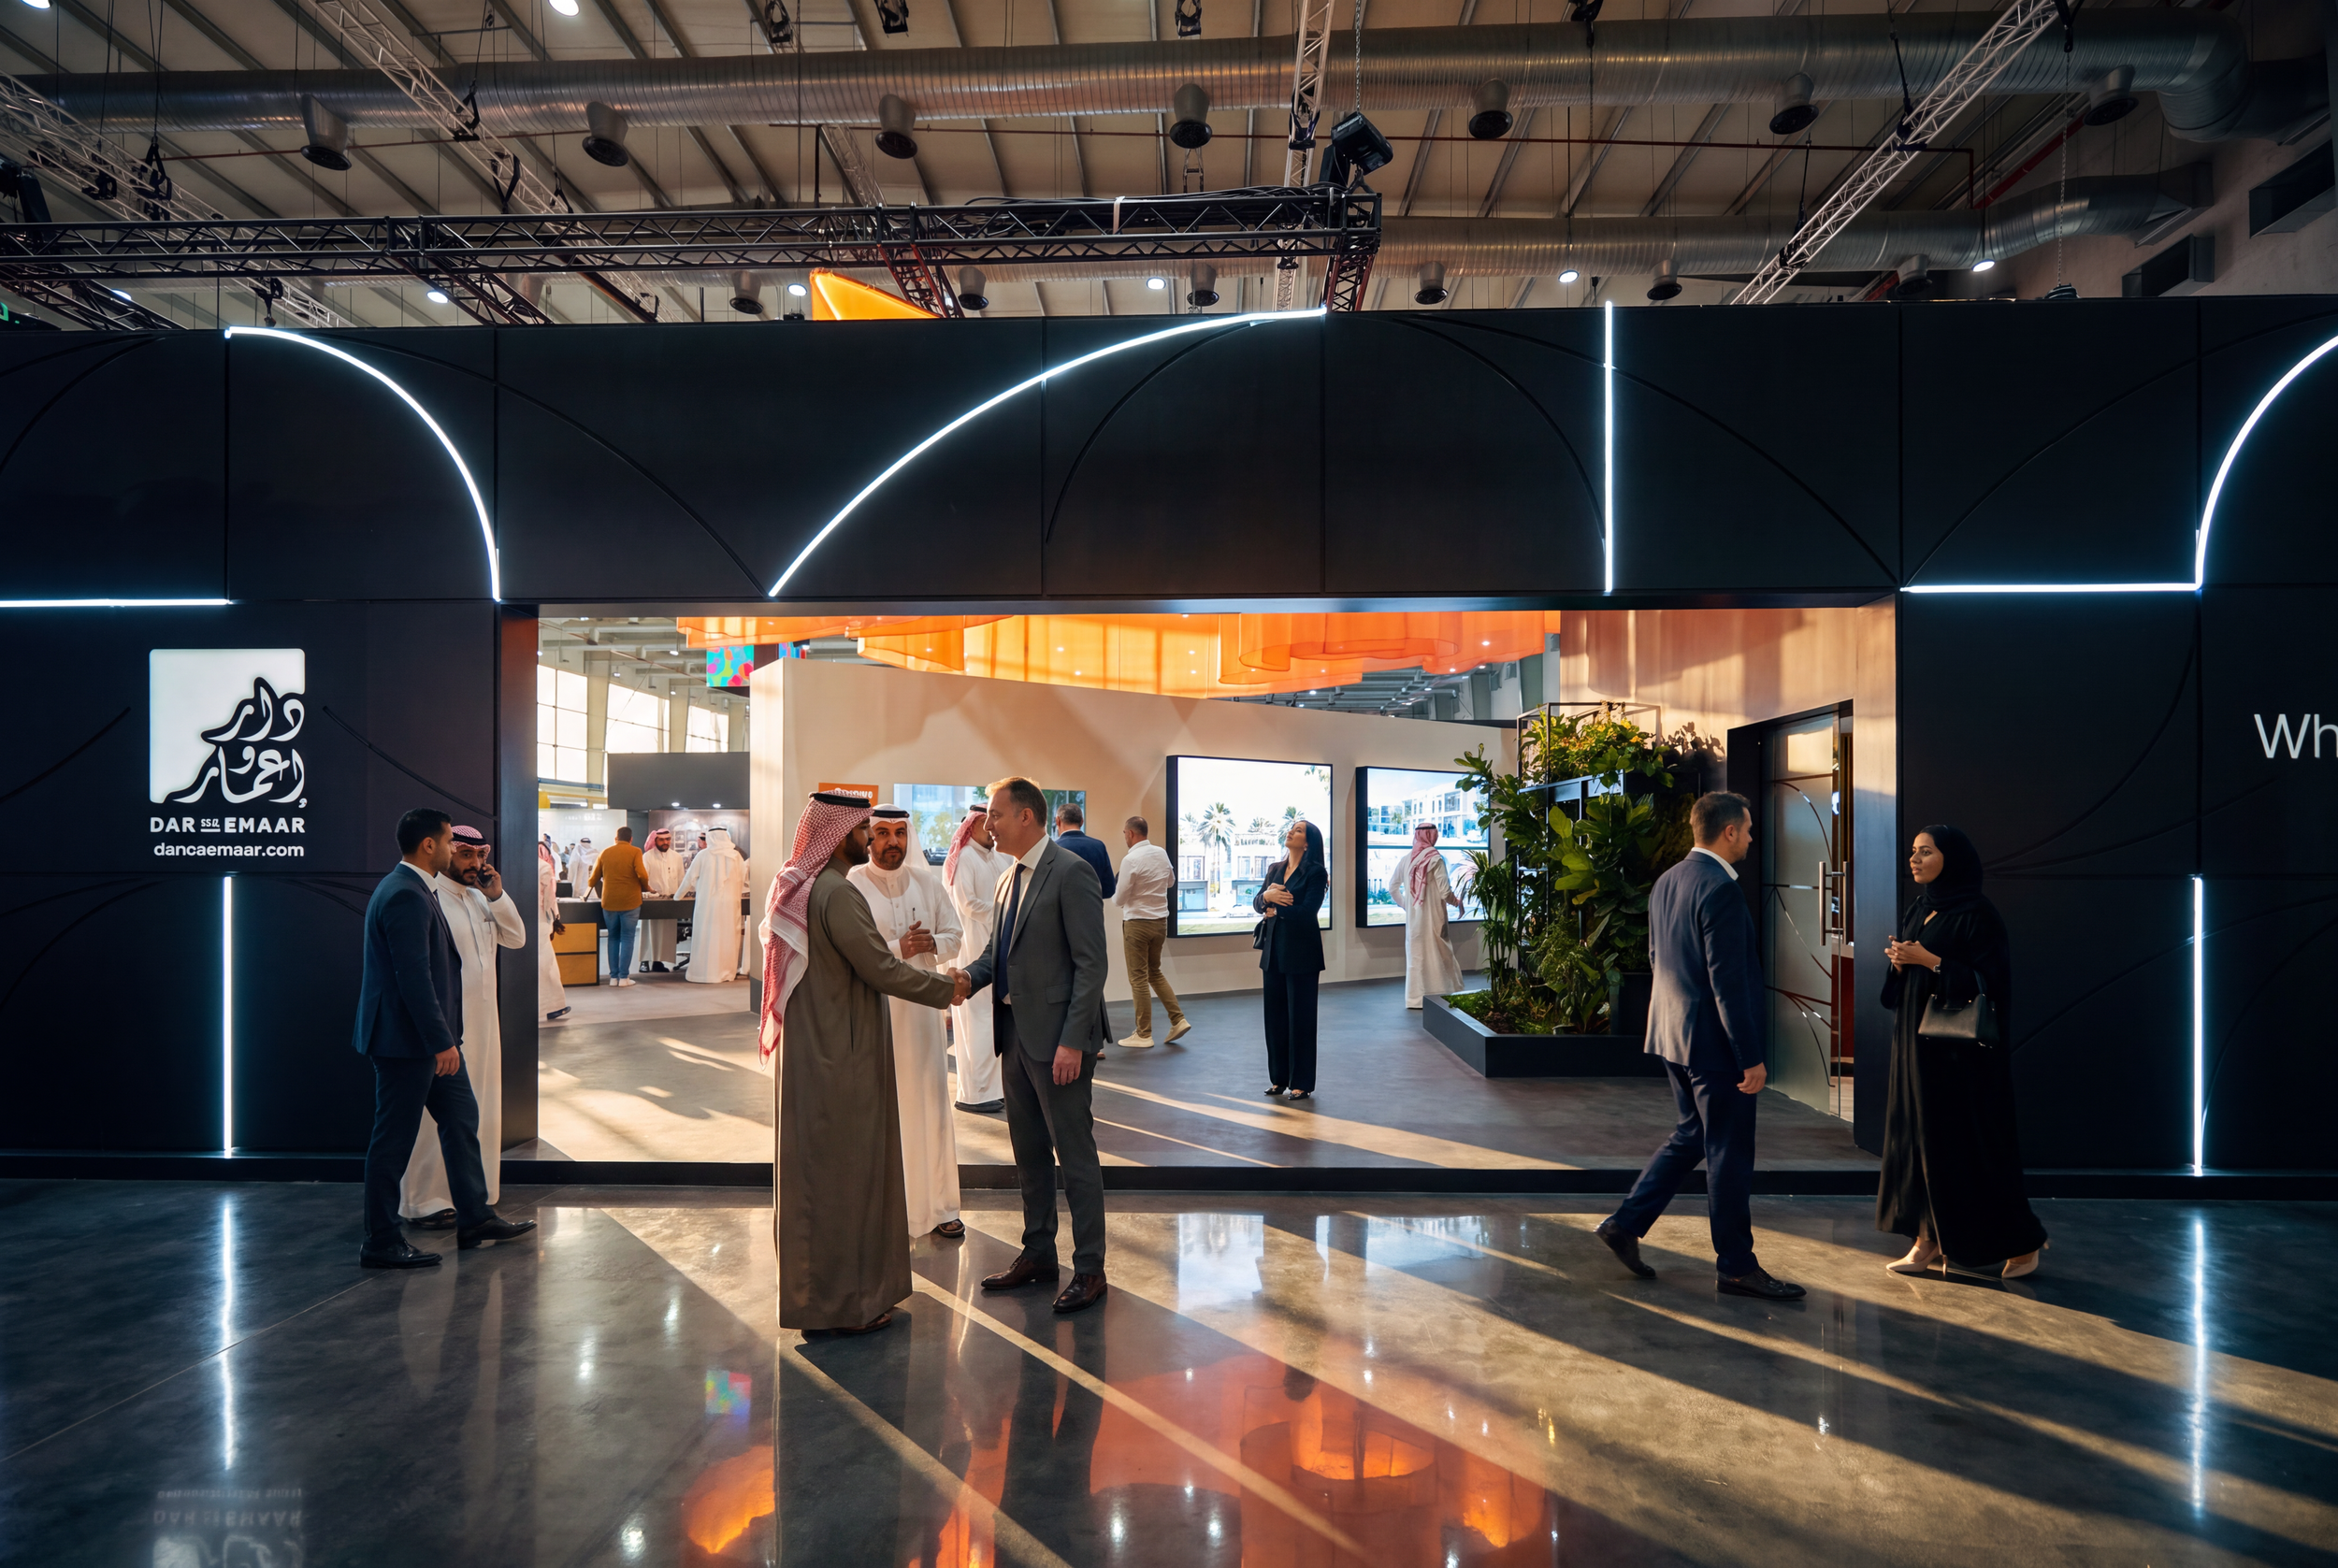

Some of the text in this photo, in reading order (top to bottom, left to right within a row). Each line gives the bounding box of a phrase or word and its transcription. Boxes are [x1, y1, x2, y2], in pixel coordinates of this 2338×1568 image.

[207, 685, 306, 742] دار
[2253, 713, 2338, 759] Wh
[150, 816, 196, 833] DAR
[224, 816, 306, 834] EMAAR
[153, 842, 305, 857] dancaemaar.com
